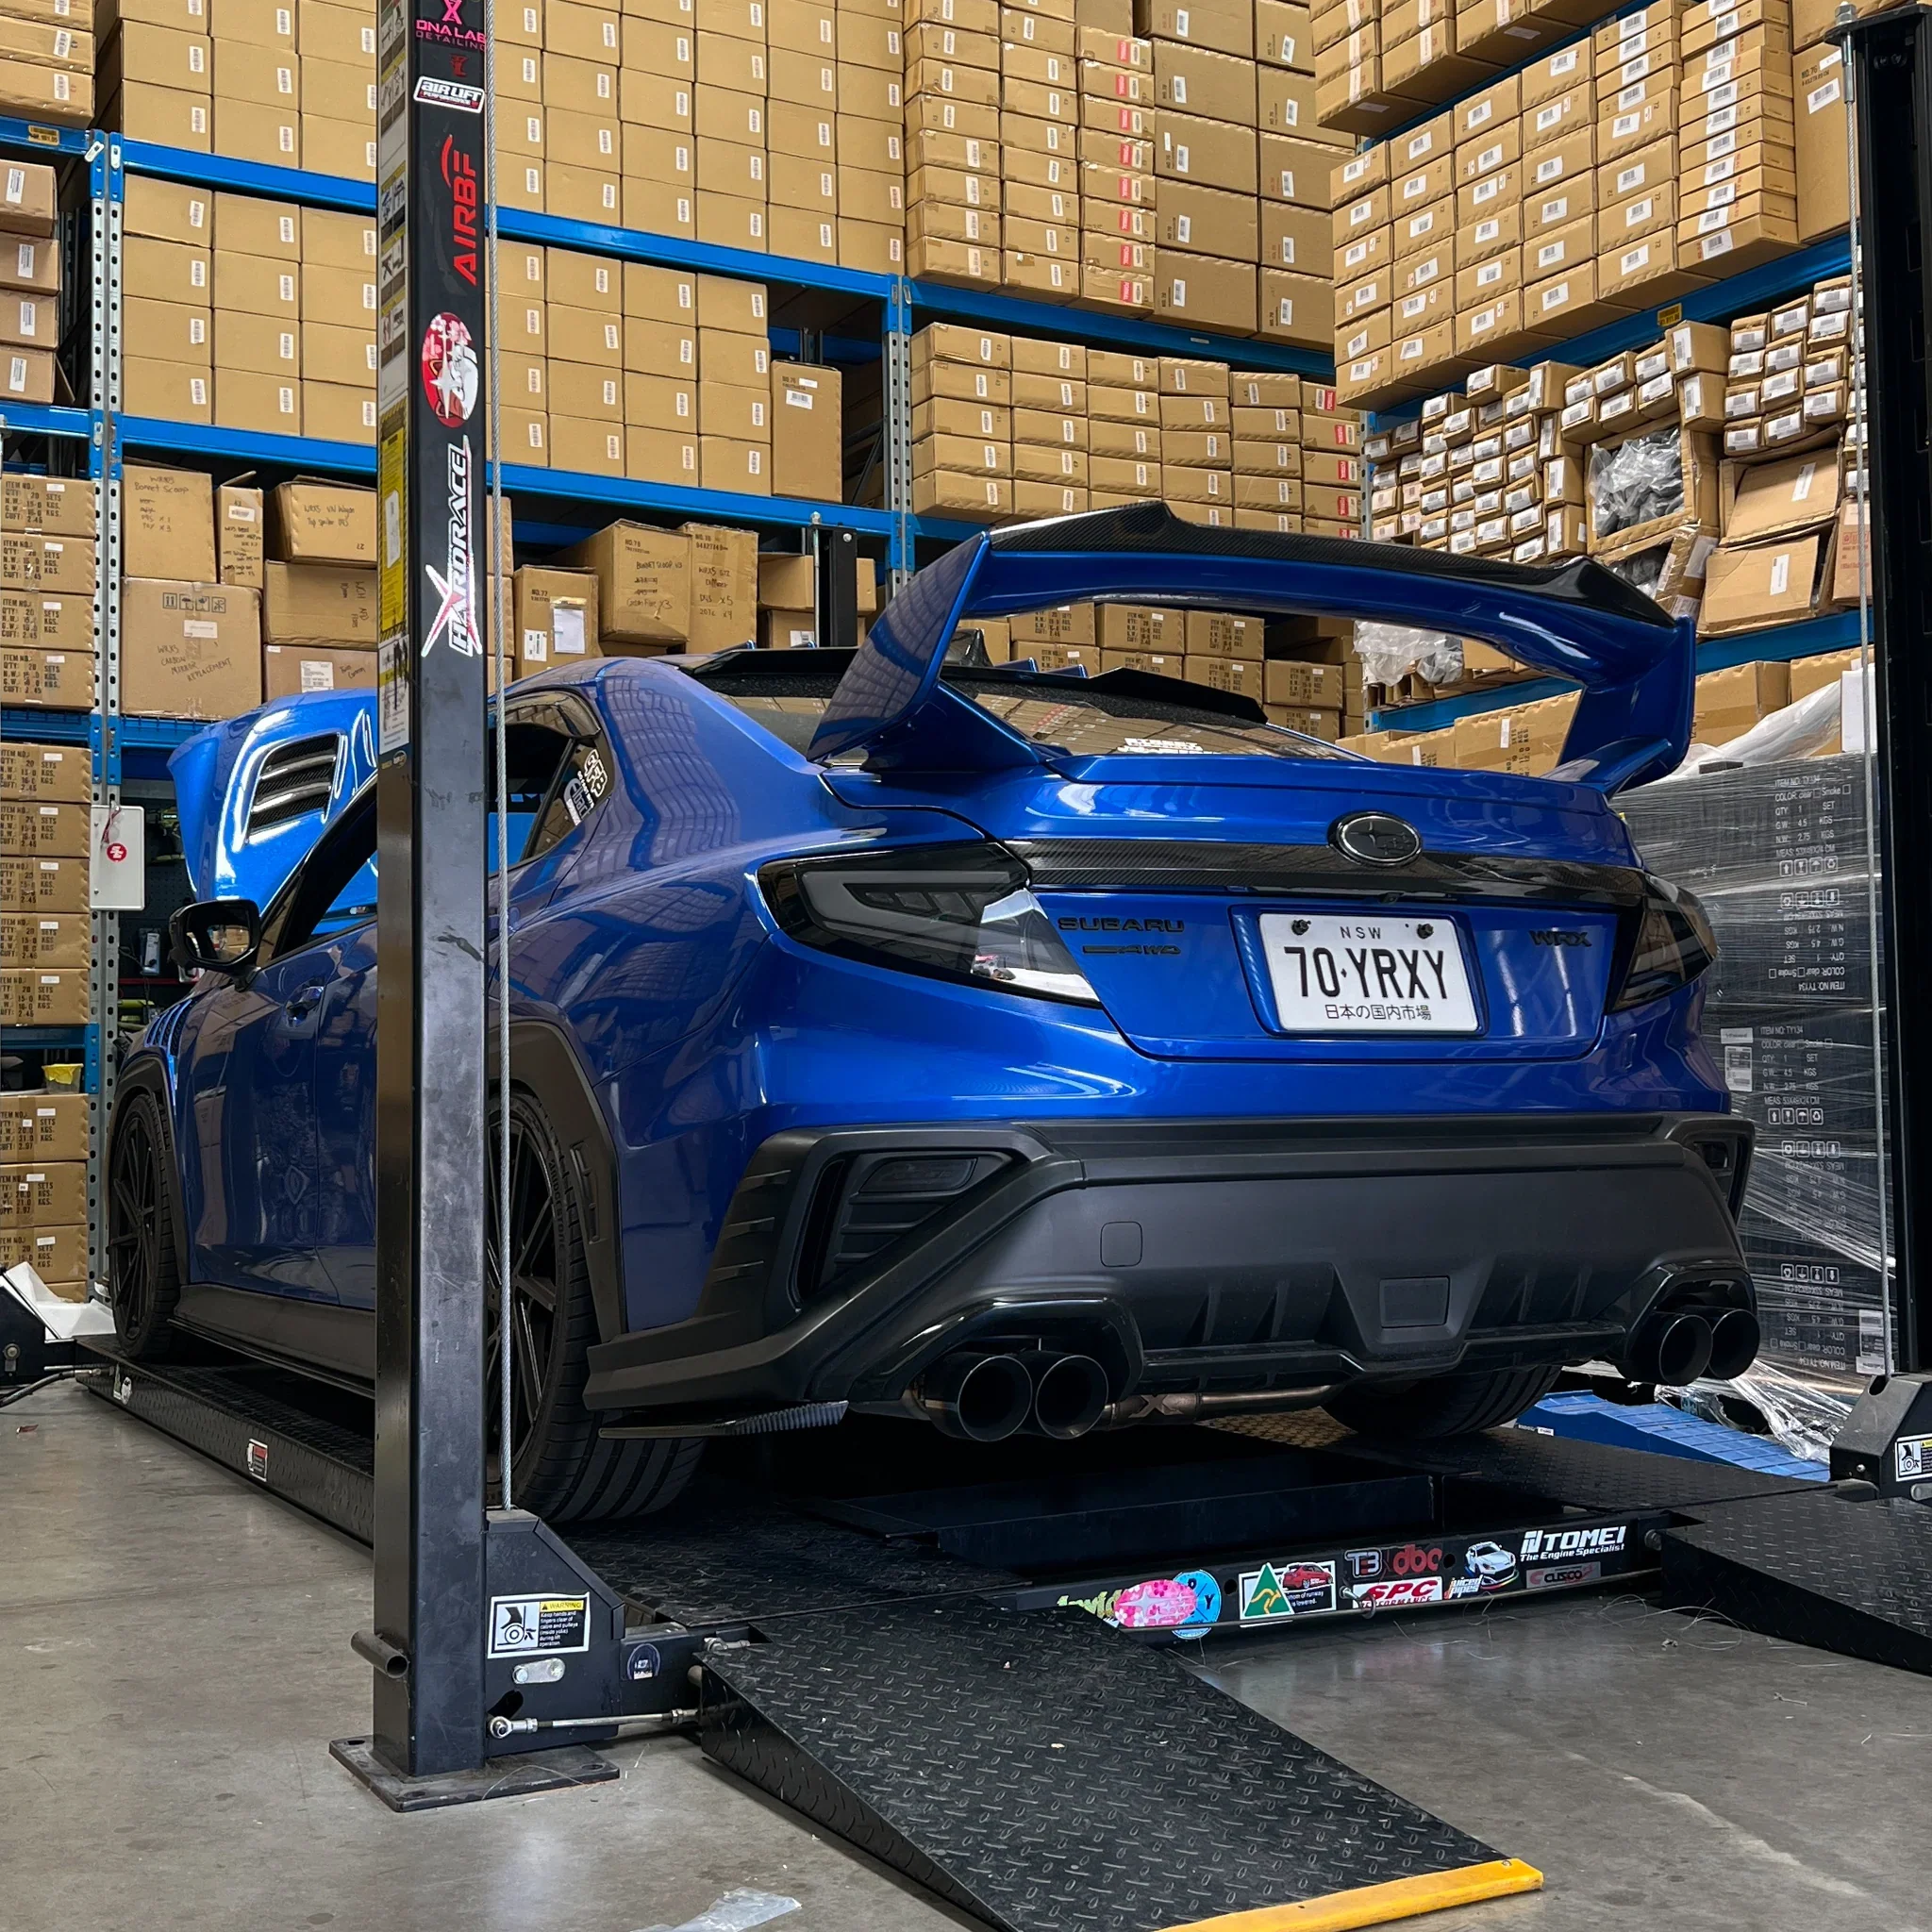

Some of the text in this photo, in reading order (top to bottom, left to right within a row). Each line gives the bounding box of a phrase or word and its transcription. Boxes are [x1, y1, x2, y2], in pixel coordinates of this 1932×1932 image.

[416, 20, 486, 44] DNA LAB
[187, 657, 232, 682] REPLACEMENT
[1822, 800, 1836, 810] SET
[1821, 829, 1835, 839] KGS
[1058, 917, 1185, 933] SUBARU
[1784, 926, 1798, 936] KGS
[1341, 926, 1381, 940] NSW
[1528, 929, 1592, 947] WRX
[1785, 941, 1800, 950] KGS
[1784, 954, 1796, 964] SET
[1777, 969, 1797, 978] Smoke
[1830, 981, 1846, 991] ITEM
[1324, 1004, 1432, 1021] 日本の国内市場
[1760, 1025, 1774, 1035] ITEM
[1806, 1053, 1819, 1062] SET
[1784, 1326, 1797, 1337] SET
[1544, 1525, 1627, 1551] TOMEI
[1520, 1542, 1625, 1562] The Engine Specialist
[1450, 1574, 1484, 1589] juiced
[1544, 1570, 1584, 1584] CUSCO
[1367, 1579, 1439, 1602] SPC
[1449, 1585, 1479, 1600] pipes
